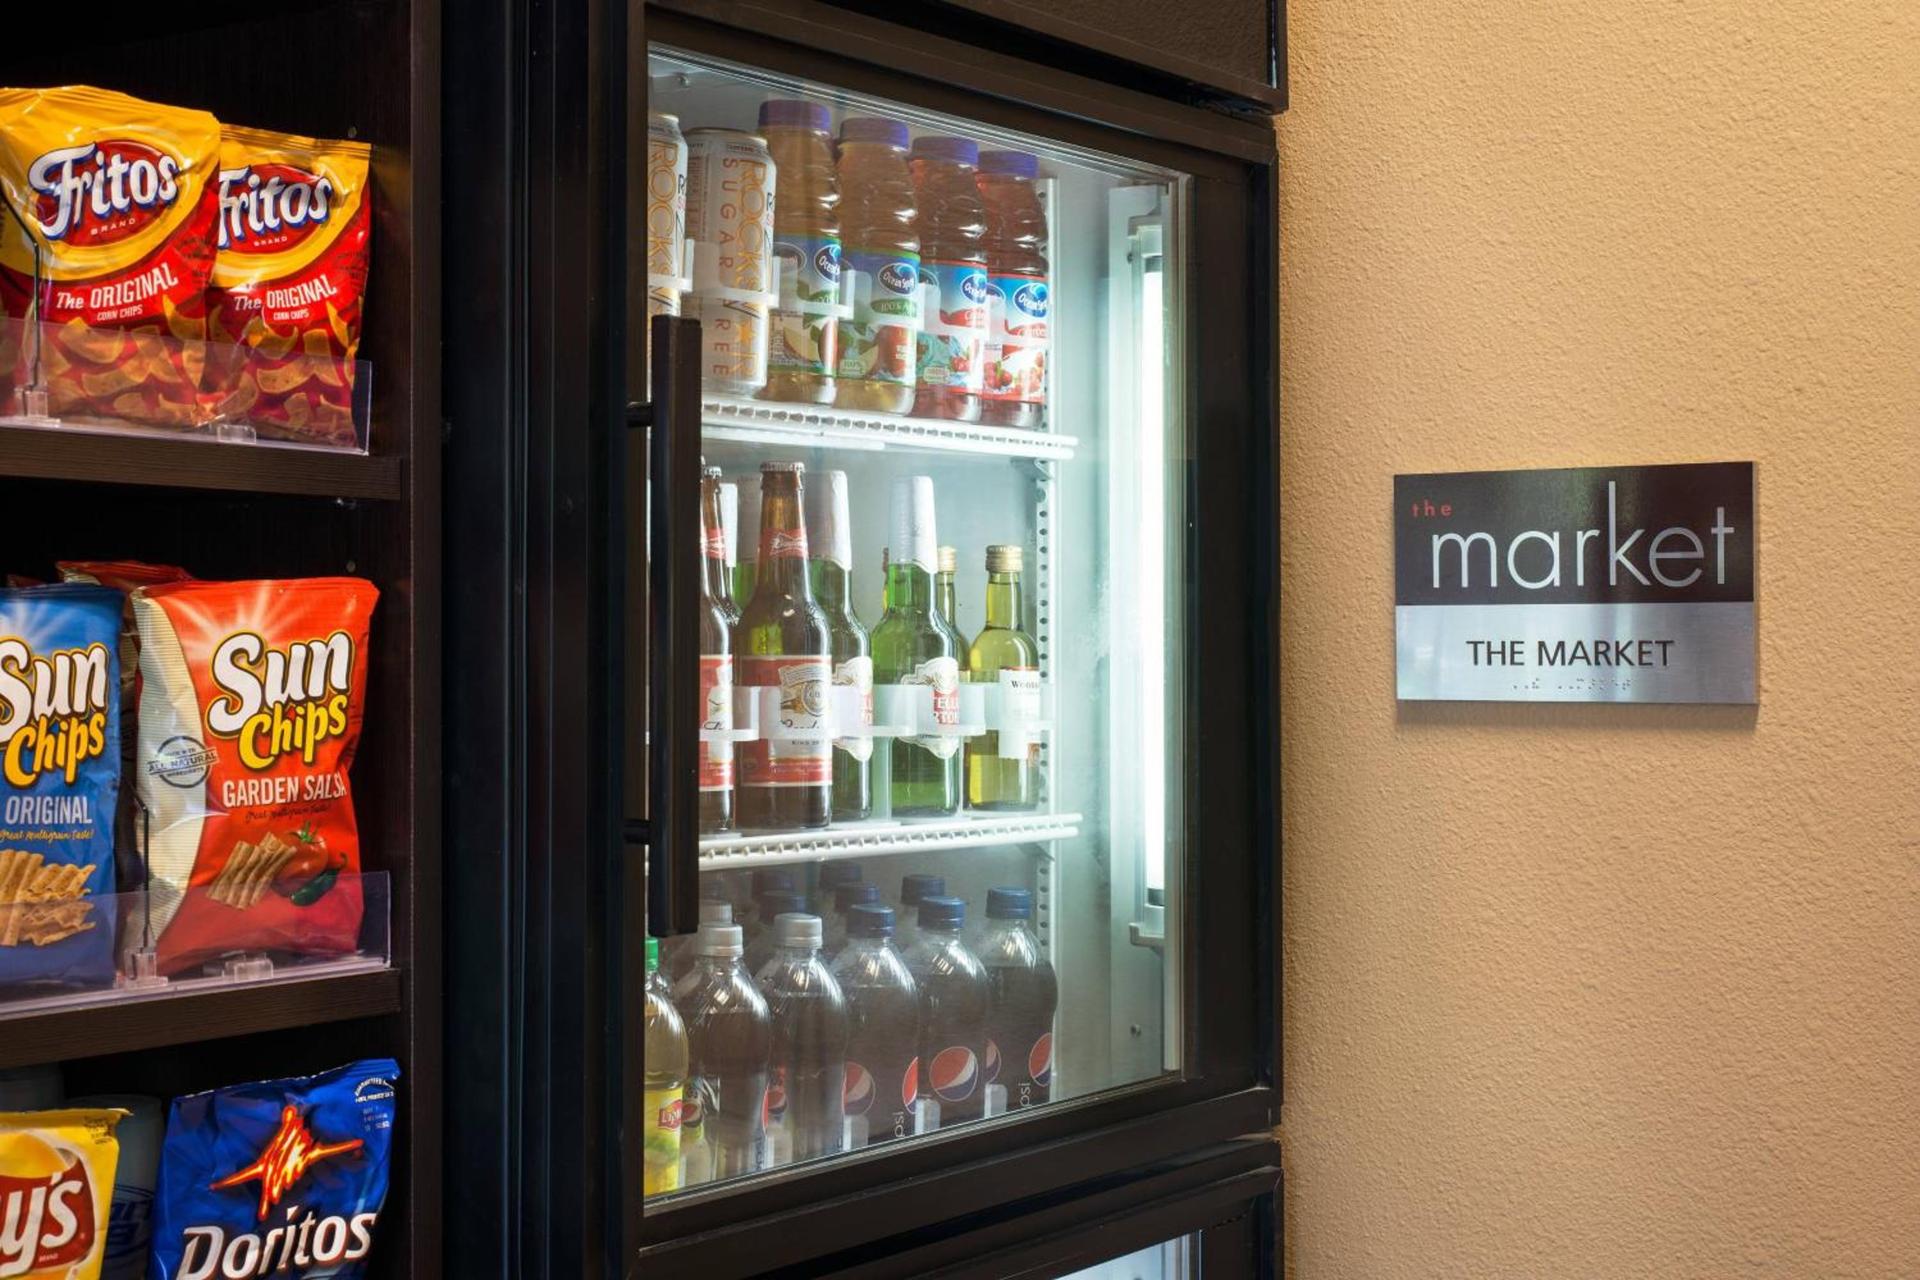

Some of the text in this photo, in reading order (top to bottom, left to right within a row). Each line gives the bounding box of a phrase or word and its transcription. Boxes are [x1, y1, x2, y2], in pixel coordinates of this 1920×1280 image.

[28, 142, 181, 241] Fritos
[719, 157, 738, 269] SUGAR
[90, 217, 136, 235] BRAND
[56, 262, 179, 309] The ORIGINAL
[119, 304, 143, 319] CHIPS
[234, 274, 337, 311] The ORIGINAL
[712, 318, 731, 376] REE
[1412, 500, 1452, 518] the
[1431, 480, 1735, 590] market
[1466, 639, 1675, 667] THE MARKET
[0, 640, 107, 744] Sun
[208, 632, 352, 733] Sun
[4, 712, 106, 788] Chips
[239, 694, 348, 769] Chips
[5, 796, 93, 825] ORIGINAL
[222, 776, 299, 808] GARDEN
[1018, 1082, 1032, 1107] psi
[893, 1111, 905, 1138] psi
[0, 1171, 84, 1279] y's
[176, 1204, 377, 1280] Doritos
